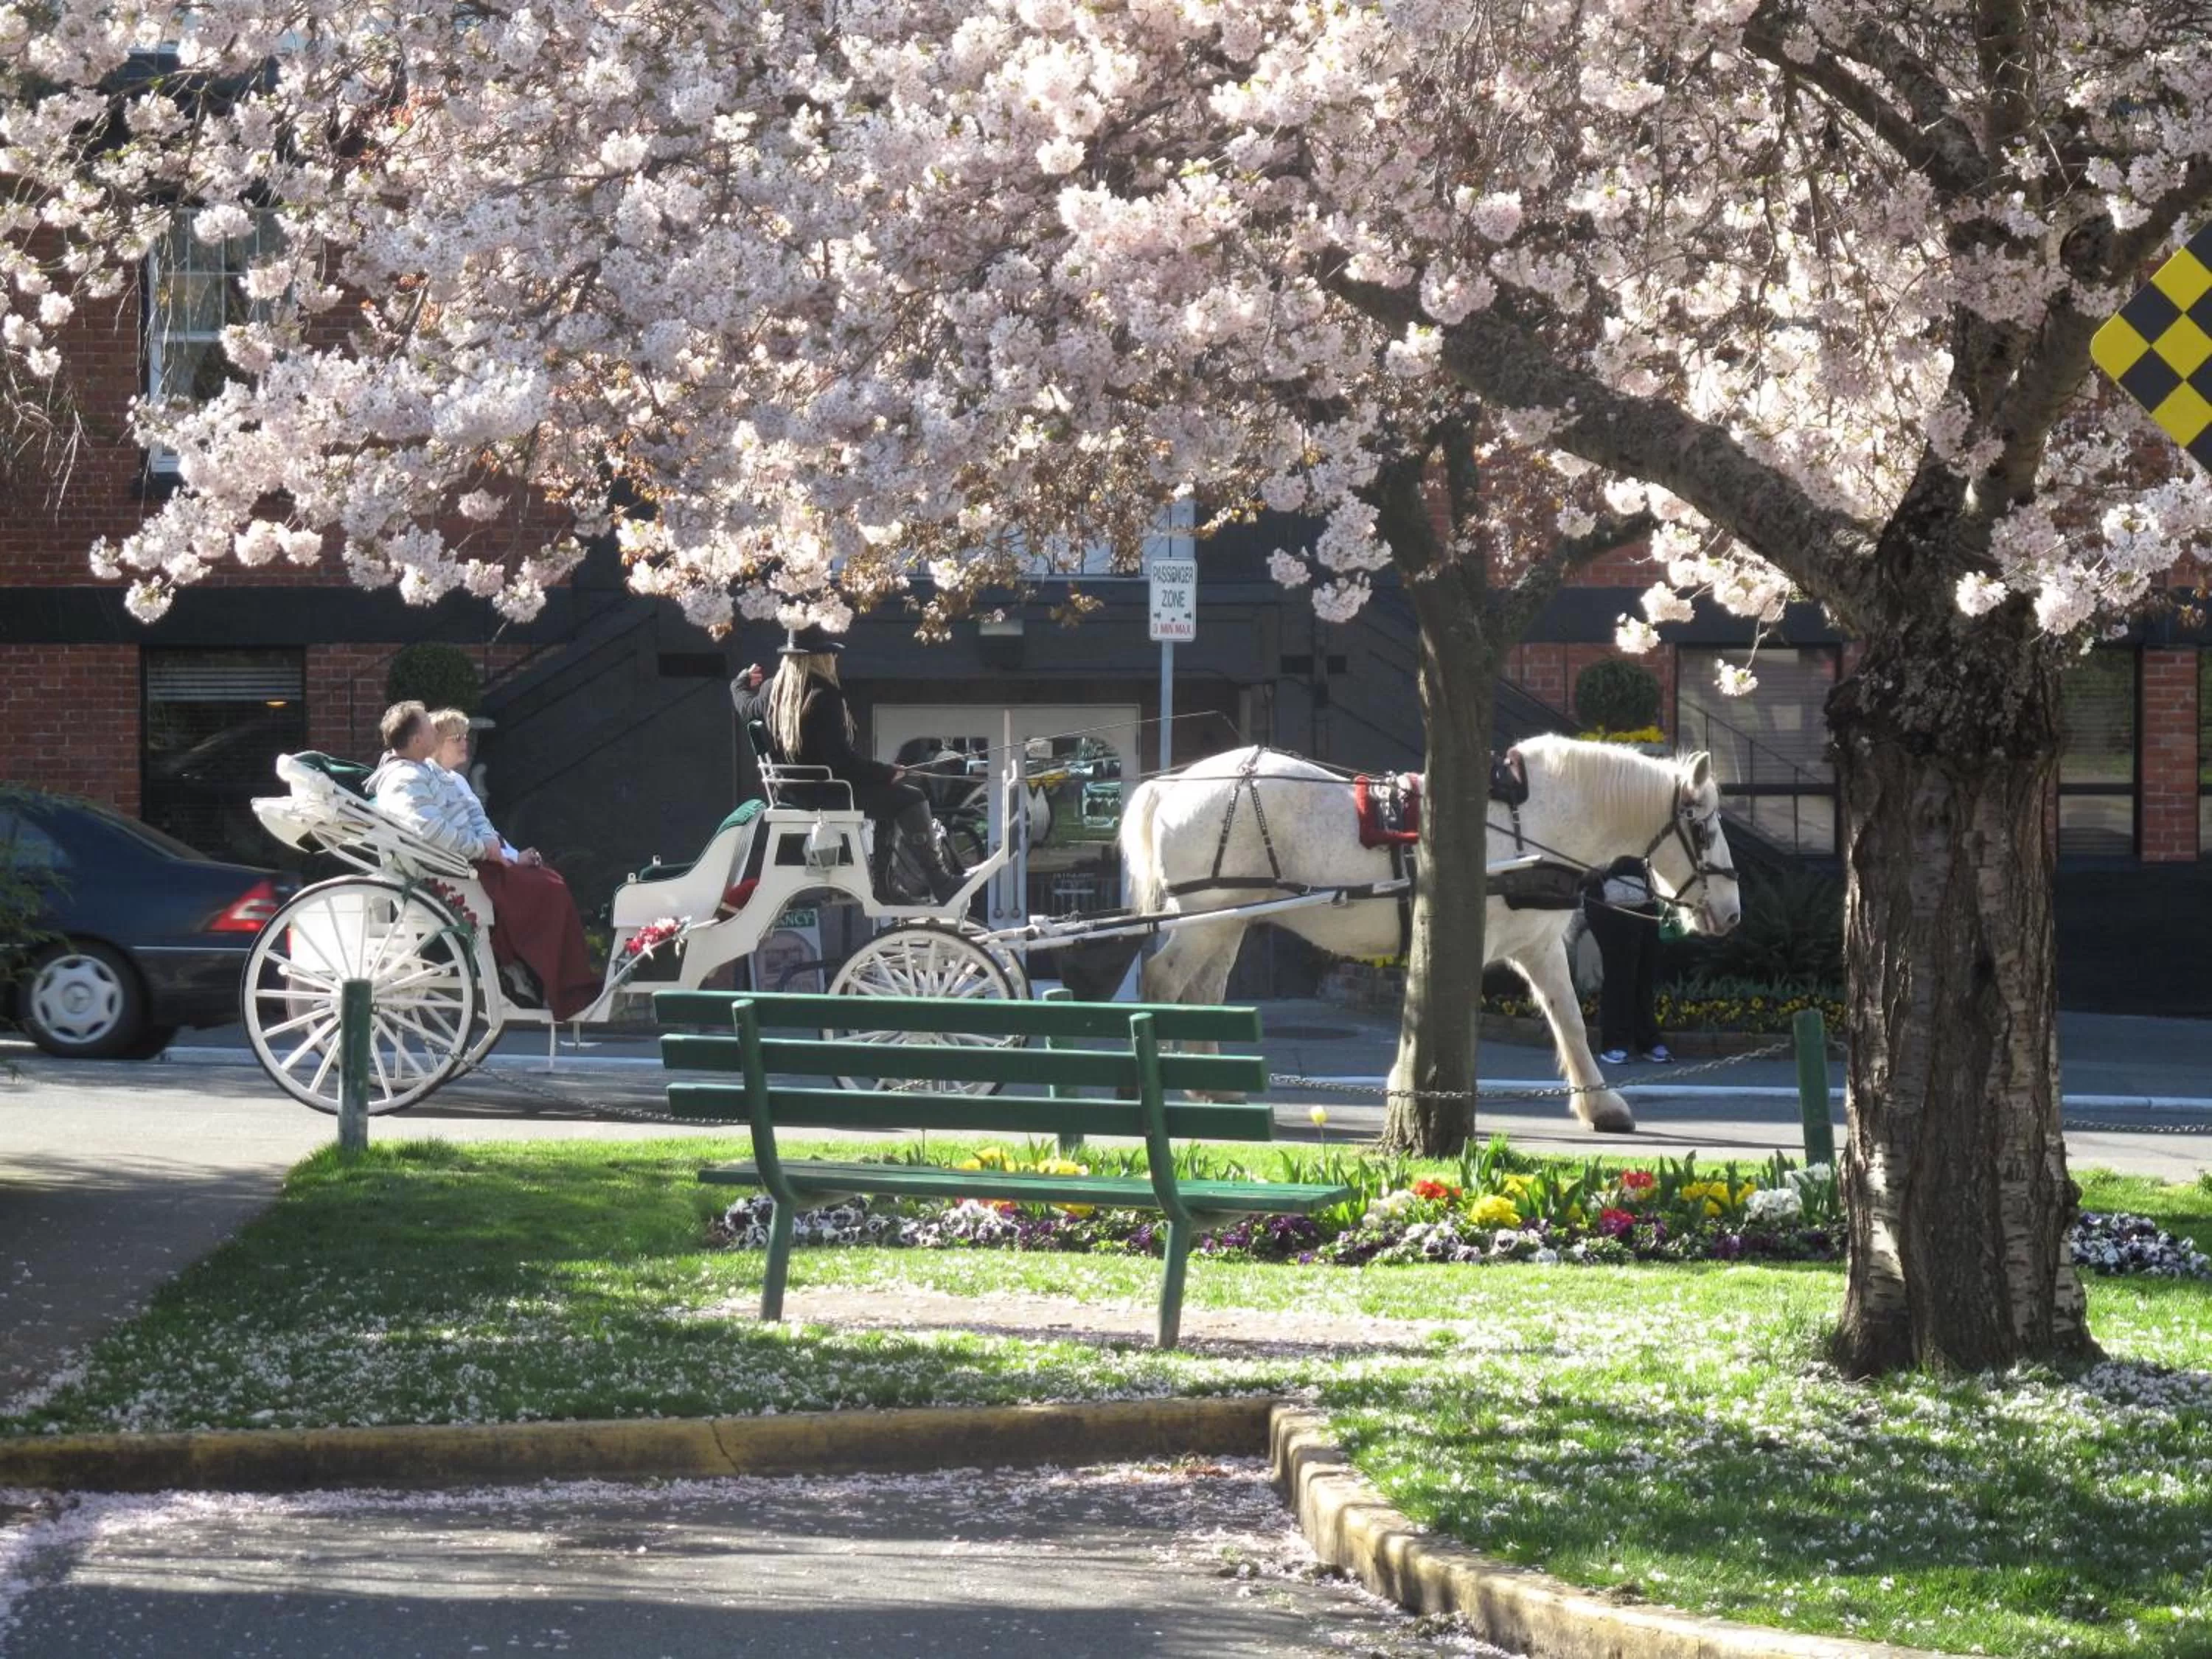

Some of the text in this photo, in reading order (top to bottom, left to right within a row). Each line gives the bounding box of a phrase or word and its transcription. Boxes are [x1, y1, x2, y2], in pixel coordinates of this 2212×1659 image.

[1161, 589, 1186, 608] ZONE
[1160, 624, 1173, 634] MIN
[1175, 624, 1192, 635] MAX
